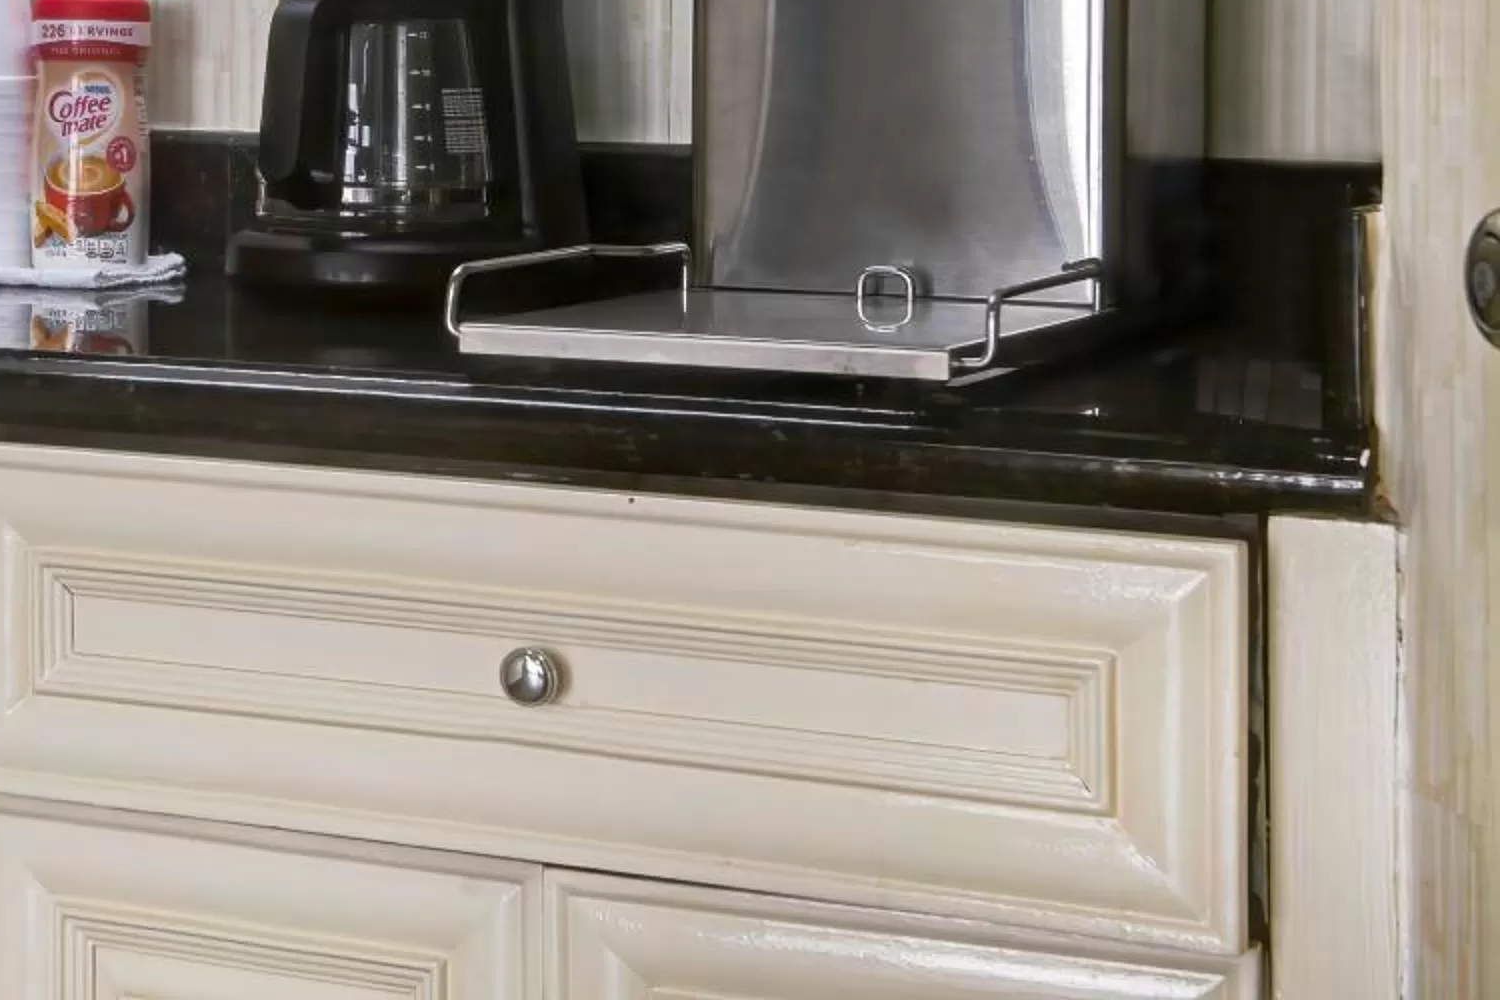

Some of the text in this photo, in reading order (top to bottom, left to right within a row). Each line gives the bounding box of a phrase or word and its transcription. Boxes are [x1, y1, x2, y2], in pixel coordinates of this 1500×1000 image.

[41, 23, 65, 39] 226
[48, 90, 112, 123] Coffee
[61, 115, 108, 137] mate
